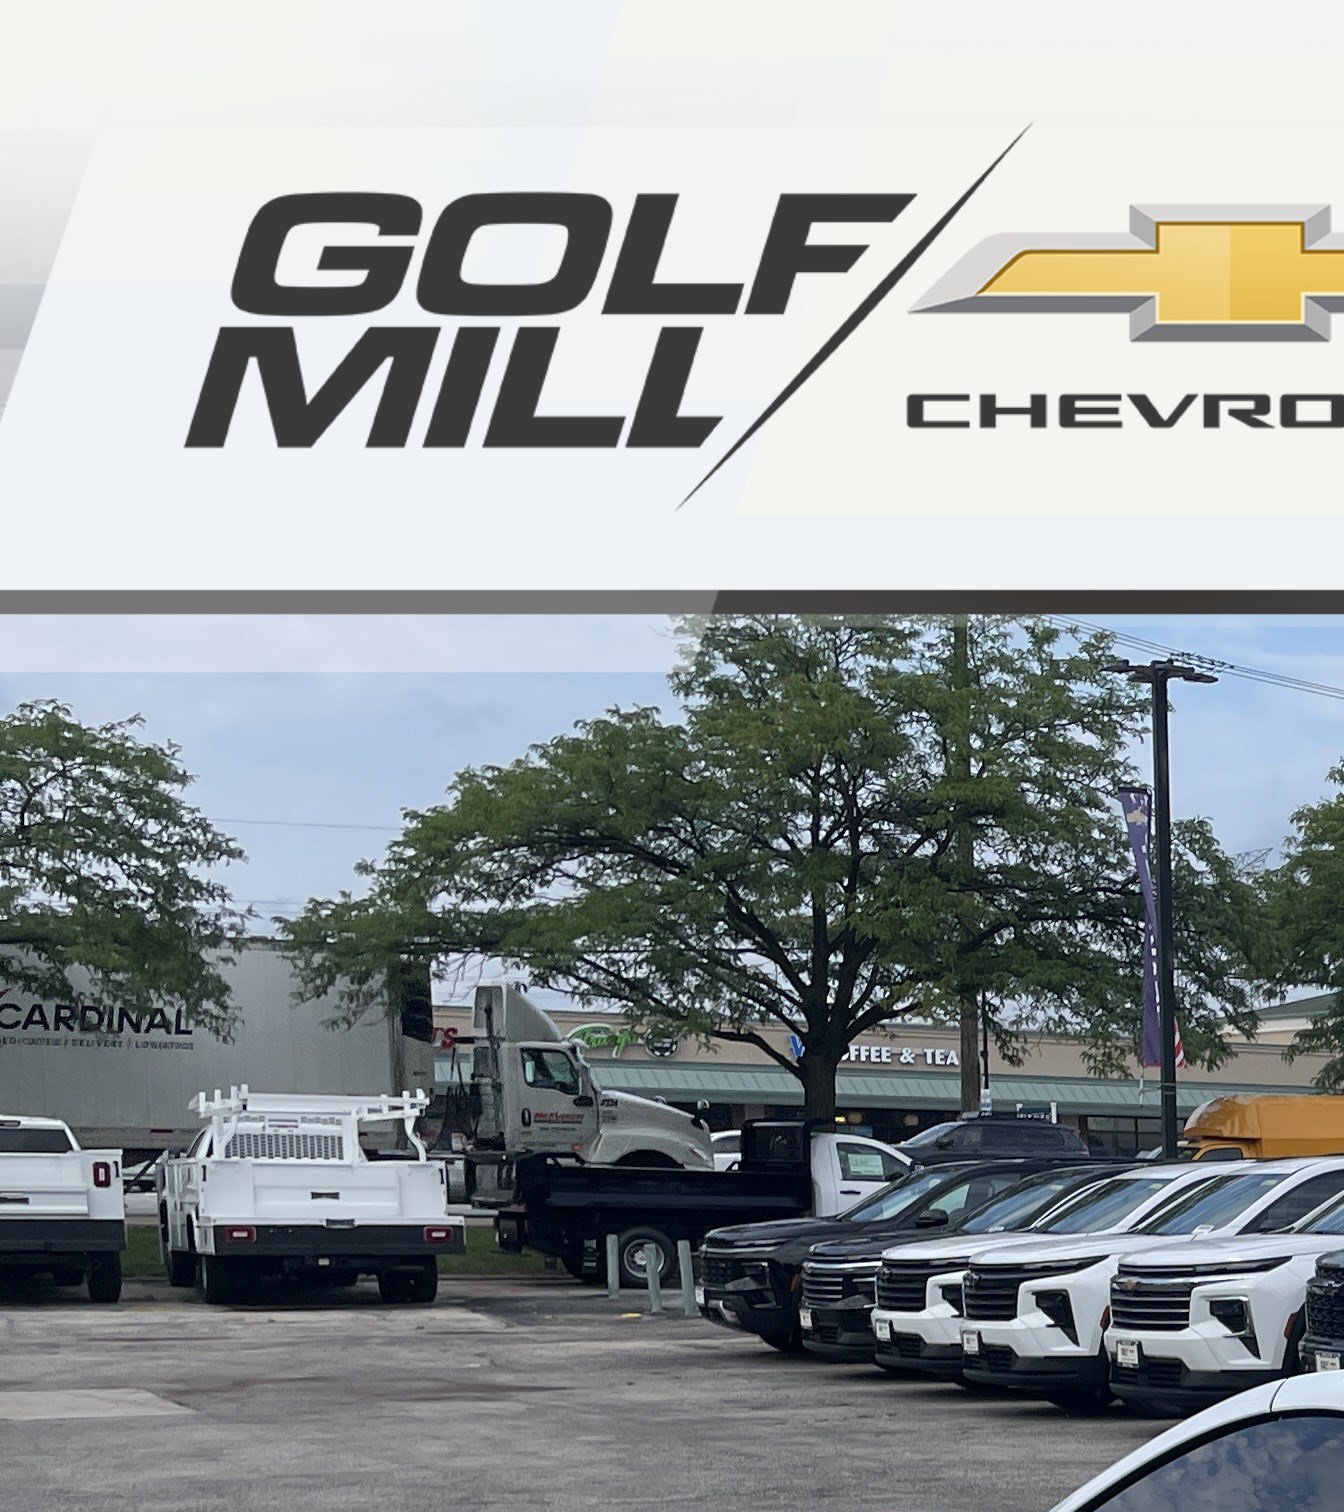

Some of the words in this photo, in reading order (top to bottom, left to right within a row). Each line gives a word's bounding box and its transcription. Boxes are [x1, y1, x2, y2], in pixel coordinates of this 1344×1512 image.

[0, 1003, 193, 1036] CARDINAL
[900, 1047, 916, 1063] &
[924, 1048, 959, 1066] TEA
